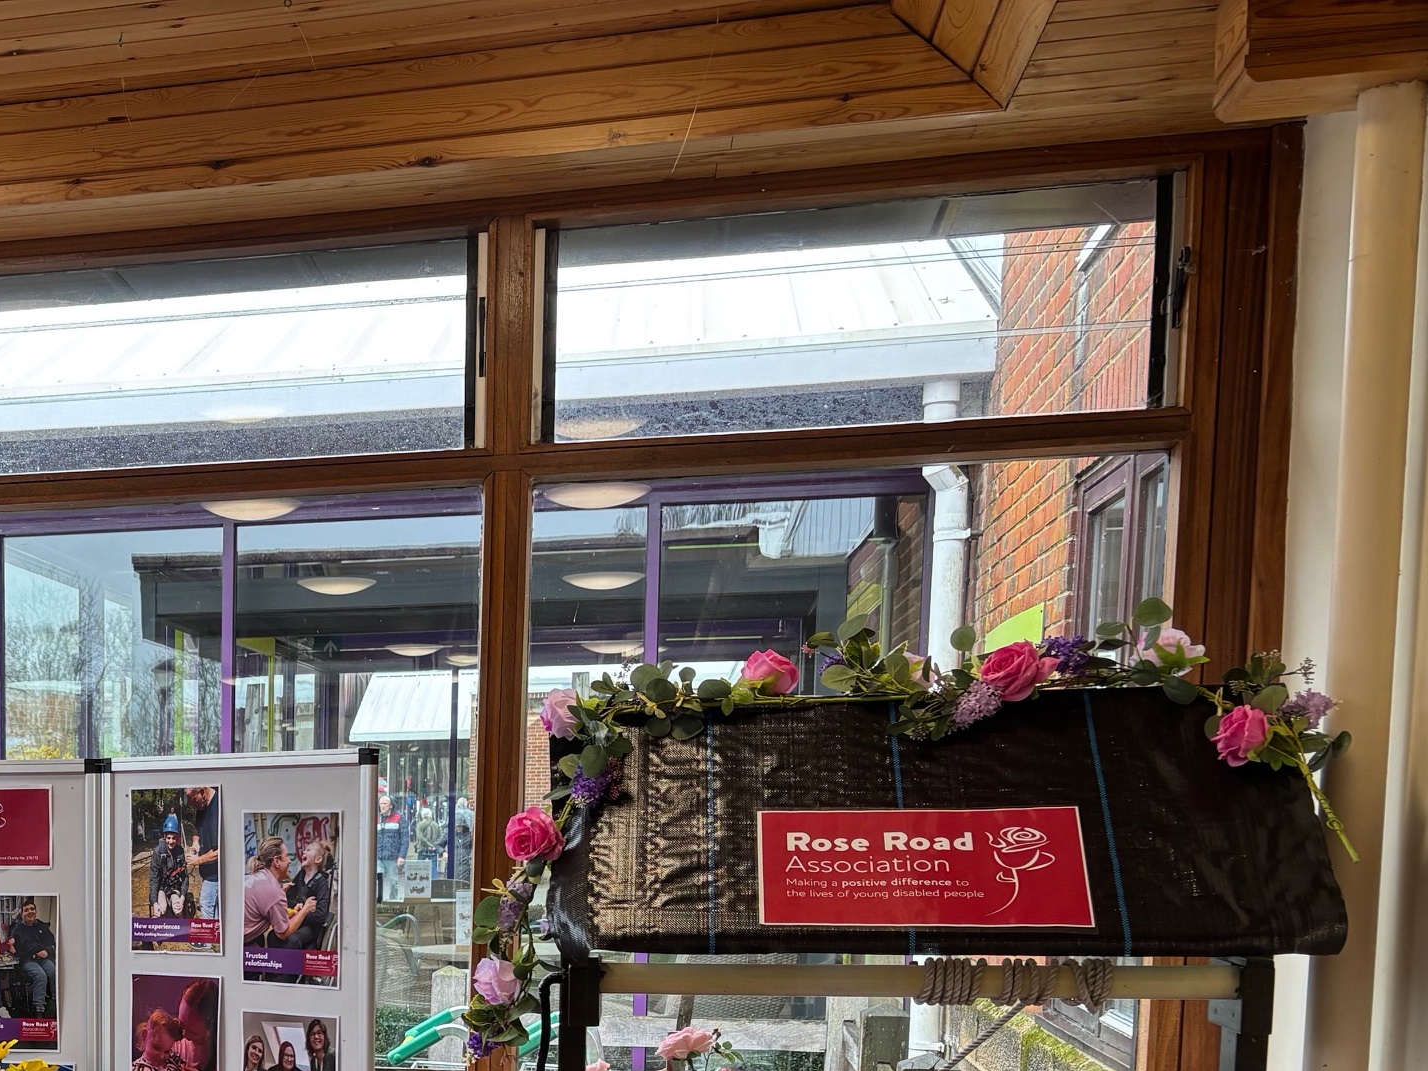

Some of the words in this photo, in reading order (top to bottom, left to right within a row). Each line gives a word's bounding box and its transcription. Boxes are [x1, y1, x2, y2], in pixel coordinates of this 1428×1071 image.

[786, 832, 870, 852] Rose
[883, 831, 974, 851] Road
[785, 855, 950, 873] Association
[786, 878, 827, 889] Making
[841, 878, 887, 889] positive
[890, 877, 952, 886] difference
[786, 889, 806, 897] the
[809, 889, 834, 898] lives
[836, 889, 850, 898] of
[852, 891, 889, 900] young
[892, 888, 940, 897] disabled
[944, 890, 985, 899] people
[133, 922, 147, 930] New
[148, 923, 181, 932] experiences
[245, 951, 268, 960] Trusted
[245, 960, 283, 969] relationships
